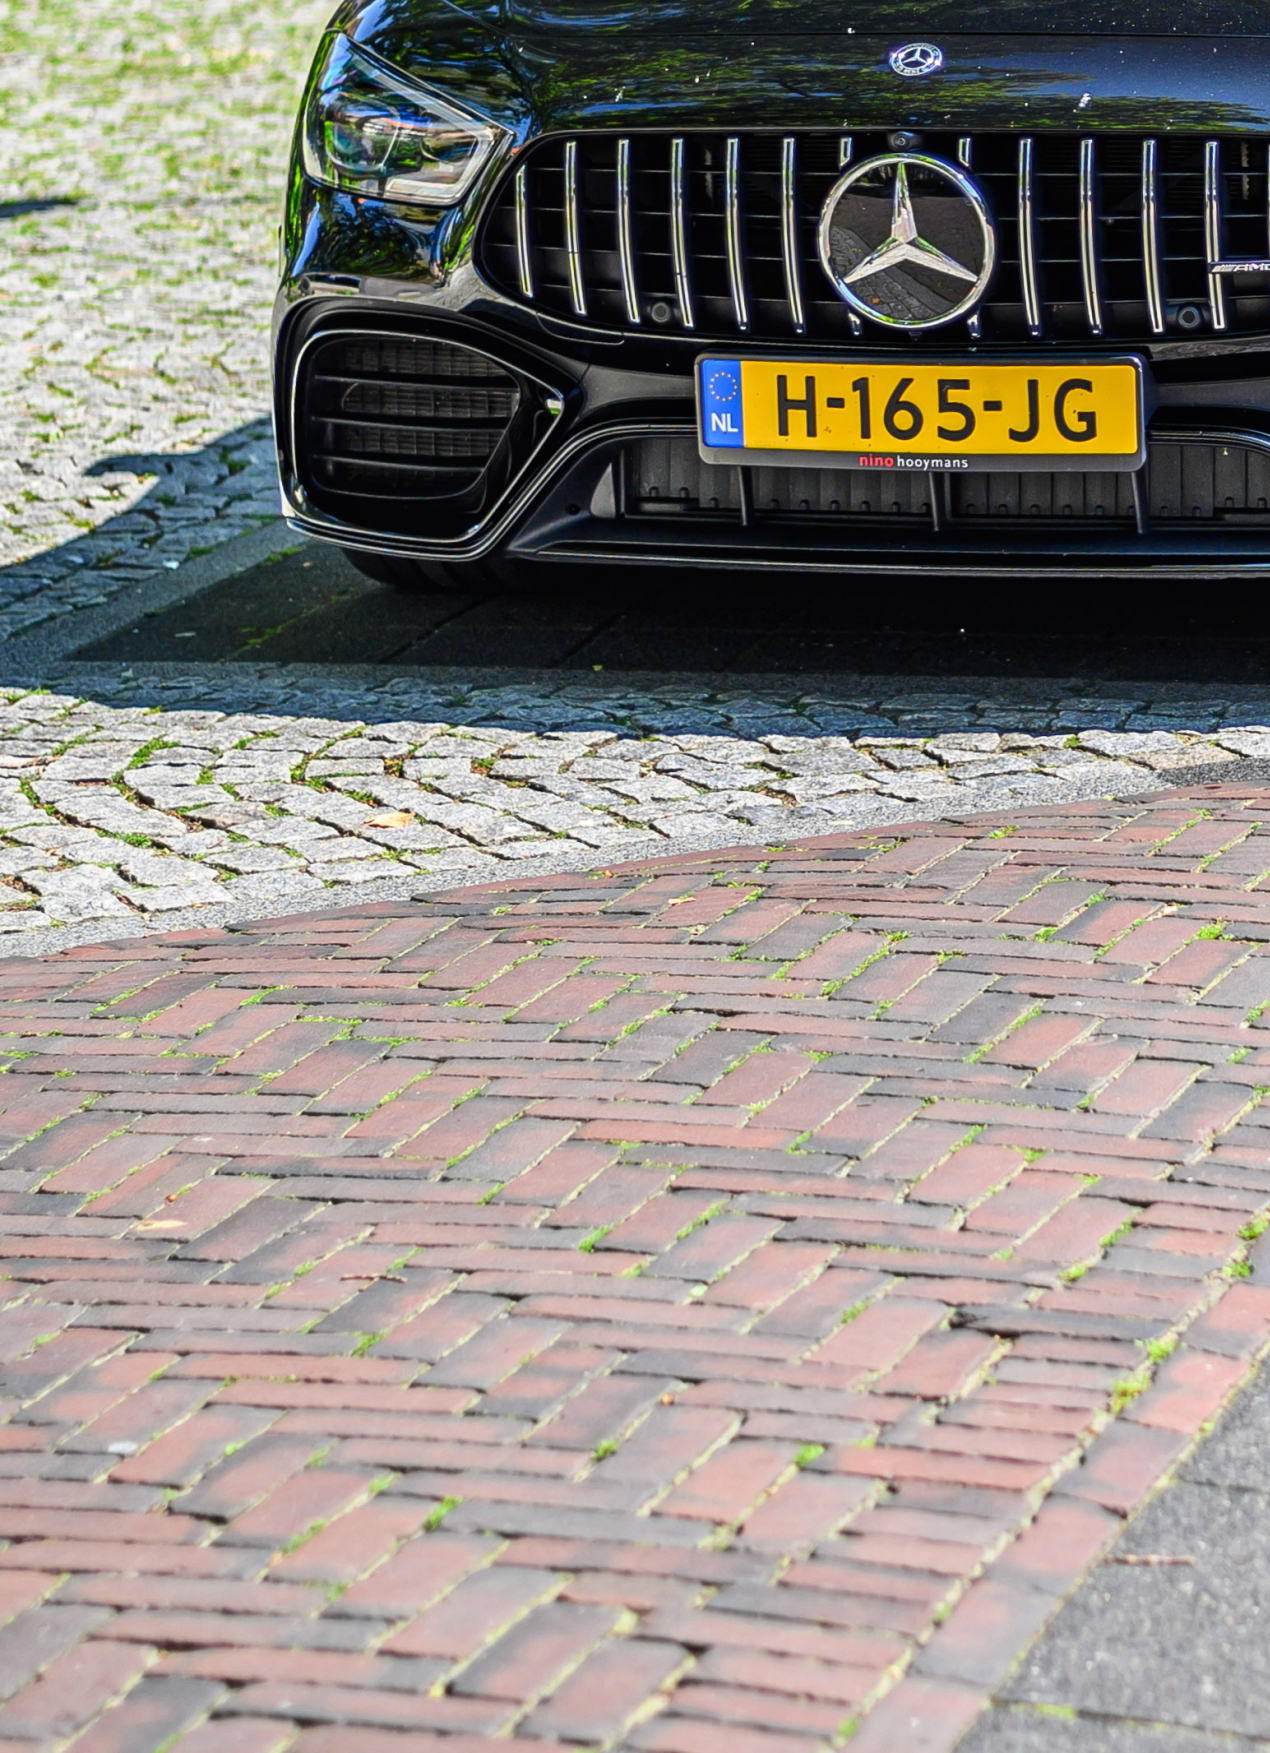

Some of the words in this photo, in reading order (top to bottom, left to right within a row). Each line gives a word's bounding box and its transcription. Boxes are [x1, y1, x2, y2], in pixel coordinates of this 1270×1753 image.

[776, 374, 1098, 443] H-165-JG
[711, 412, 739, 433] NL
[859, 453, 894, 467] nino
[897, 454, 969, 471] hooymans
